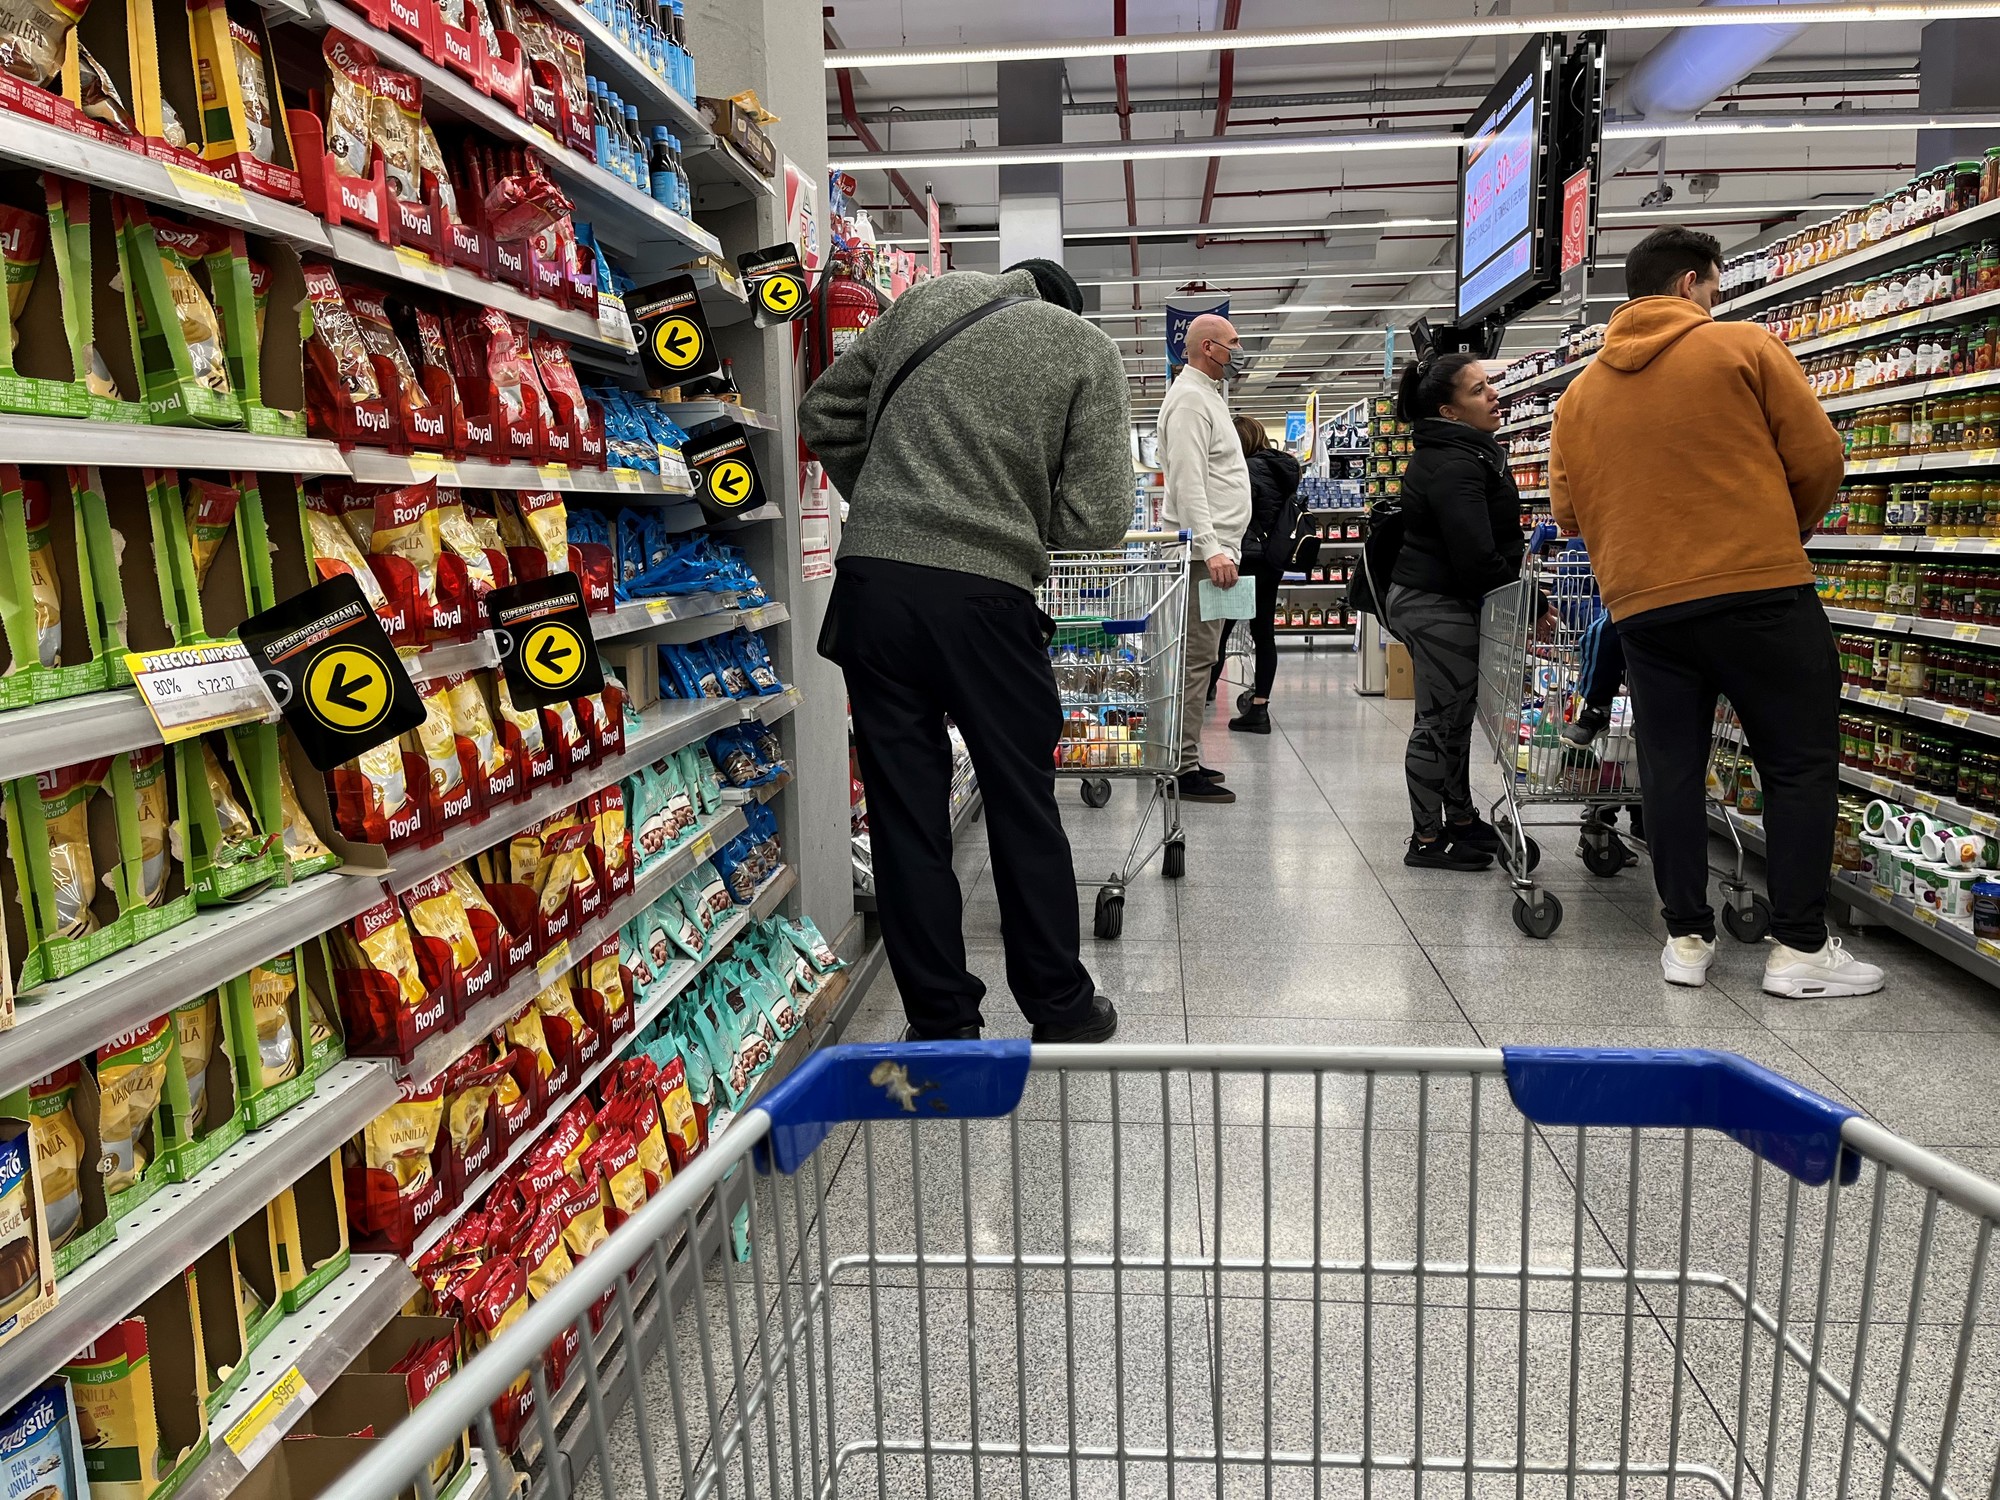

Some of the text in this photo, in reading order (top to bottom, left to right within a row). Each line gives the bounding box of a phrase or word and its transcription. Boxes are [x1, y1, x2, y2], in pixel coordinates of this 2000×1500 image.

[390, 0, 419, 28] Royal
[330, 42, 359, 76] Royal
[445, 32, 471, 63] Royal
[491, 64, 514, 91] Royal
[533, 91, 555, 118] Royal
[572, 117, 591, 142] Royal
[400, 206, 432, 236] Royal
[453, 227, 479, 253] Royal
[540, 241, 546, 249] 8
[498, 246, 522, 271] Royal
[307, 272, 336, 294] oyal
[540, 264, 560, 287] Royal
[574, 278, 593, 298] Royal
[1461, 344, 1468, 352] 9
[150, 396, 181, 414] oyal
[355, 405, 390, 430] Royal
[414, 411, 444, 435] Royal
[467, 423, 492, 443] Royal
[511, 428, 533, 445] Royal
[549, 430, 569, 449] Royal
[583, 437, 600, 454] Royal
[591, 582, 609, 600] Royal
[433, 605, 461, 628] Royal
[501, 594, 577, 622] SUPERFINDESEMANA
[530, 608, 550, 618] COTO
[266, 603, 363, 658] SUPERFINDESEMANA
[306, 629, 330, 646] COTO
[142, 650, 201, 671] PRECIOS
[153, 678, 181, 696] 80%
[602, 727, 619, 747] Royal
[572, 740, 590, 762] Royal
[434, 772, 443, 782] 8
[532, 754, 553, 777] Royal
[490, 770, 514, 795] Royal
[444, 789, 471, 819] Royal
[389, 809, 421, 840] Royal
[613, 867, 629, 891] Royal
[582, 889, 600, 914] Royal
[548, 910, 568, 936] Royal
[509, 935, 532, 965] Royal
[467, 962, 492, 996] Royal
[415, 996, 444, 1033] Royal
[612, 1006, 629, 1033] Royal
[582, 1033, 599, 1063] Royal
[112, 1077, 153, 1106] VAINILLA
[548, 1066, 568, 1096] Royal
[508, 1099, 531, 1135] Royal
[389, 1126, 429, 1144] VAINILLA
[104, 1158, 112, 1170] 8
[465, 1137, 490, 1175] Royal
[532, 1166, 564, 1192] Royal
[413, 1181, 443, 1224] Royal
[563, 1186, 599, 1219] Royal
[533, 1226, 557, 1265] Royal
[87, 1369, 118, 1383] Light
[11, 1459, 27, 1477] FLAN
